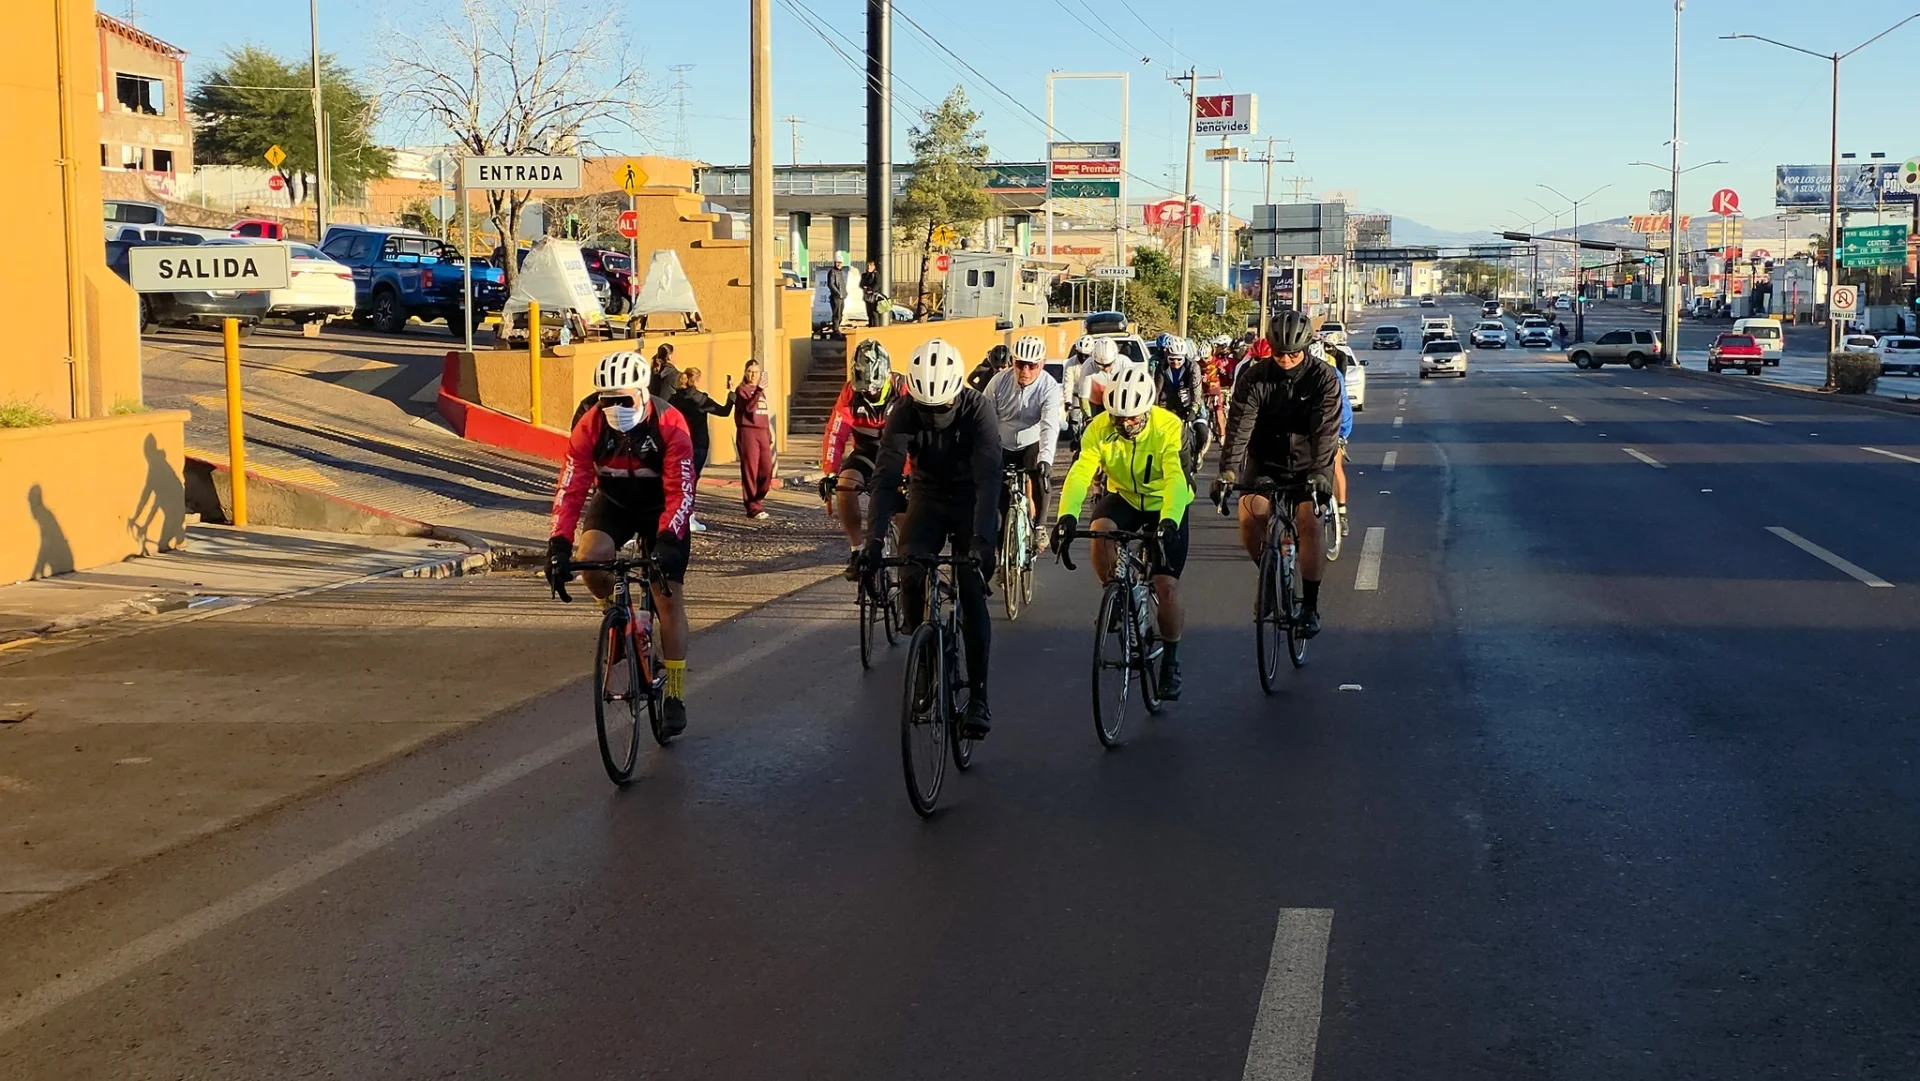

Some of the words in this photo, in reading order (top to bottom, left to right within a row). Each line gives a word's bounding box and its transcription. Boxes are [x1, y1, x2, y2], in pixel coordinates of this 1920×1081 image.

[1196, 120, 1248, 132] benavides
[479, 164, 563, 181] ENTRADA
[1081, 164, 1119, 173] Premium
[1719, 191, 1738, 212] K
[619, 218, 638, 230] ALT
[1632, 215, 1692, 231] TECAE
[158, 258, 259, 279] SALIDA
